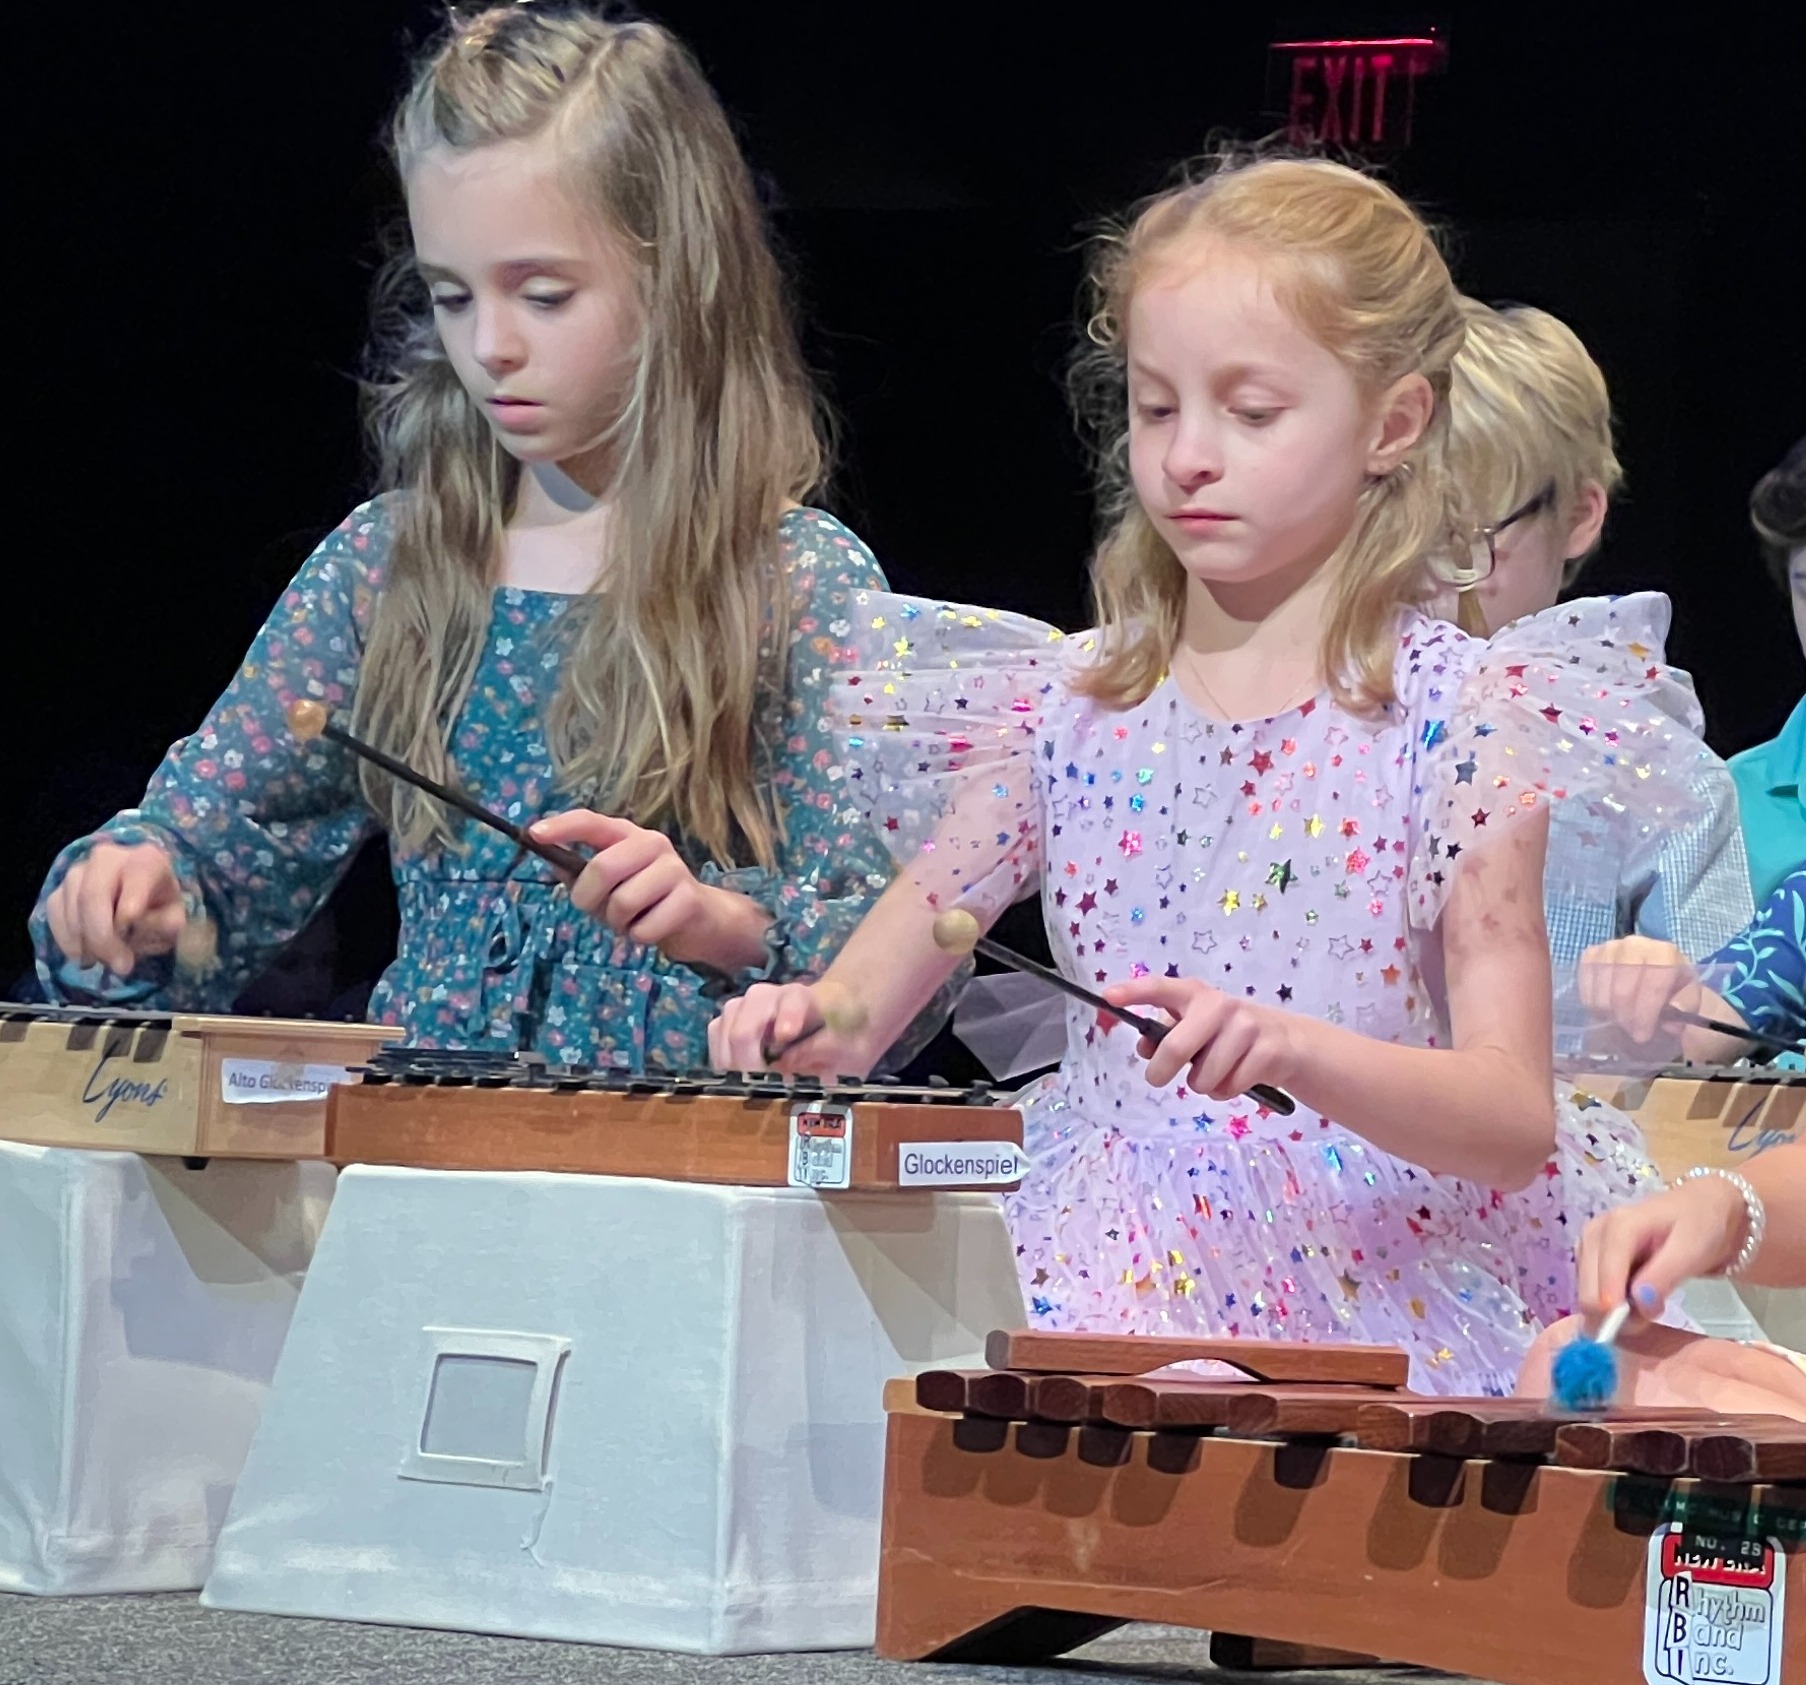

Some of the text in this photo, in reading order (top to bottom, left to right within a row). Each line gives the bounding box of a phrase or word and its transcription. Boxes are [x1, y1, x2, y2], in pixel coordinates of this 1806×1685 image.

[1288, 55, 1393, 144] EXIT
[83, 1039, 167, 1122] Lyons
[229, 1072, 256, 1088] Alto
[904, 1153, 1018, 1179] Glockenspiel
